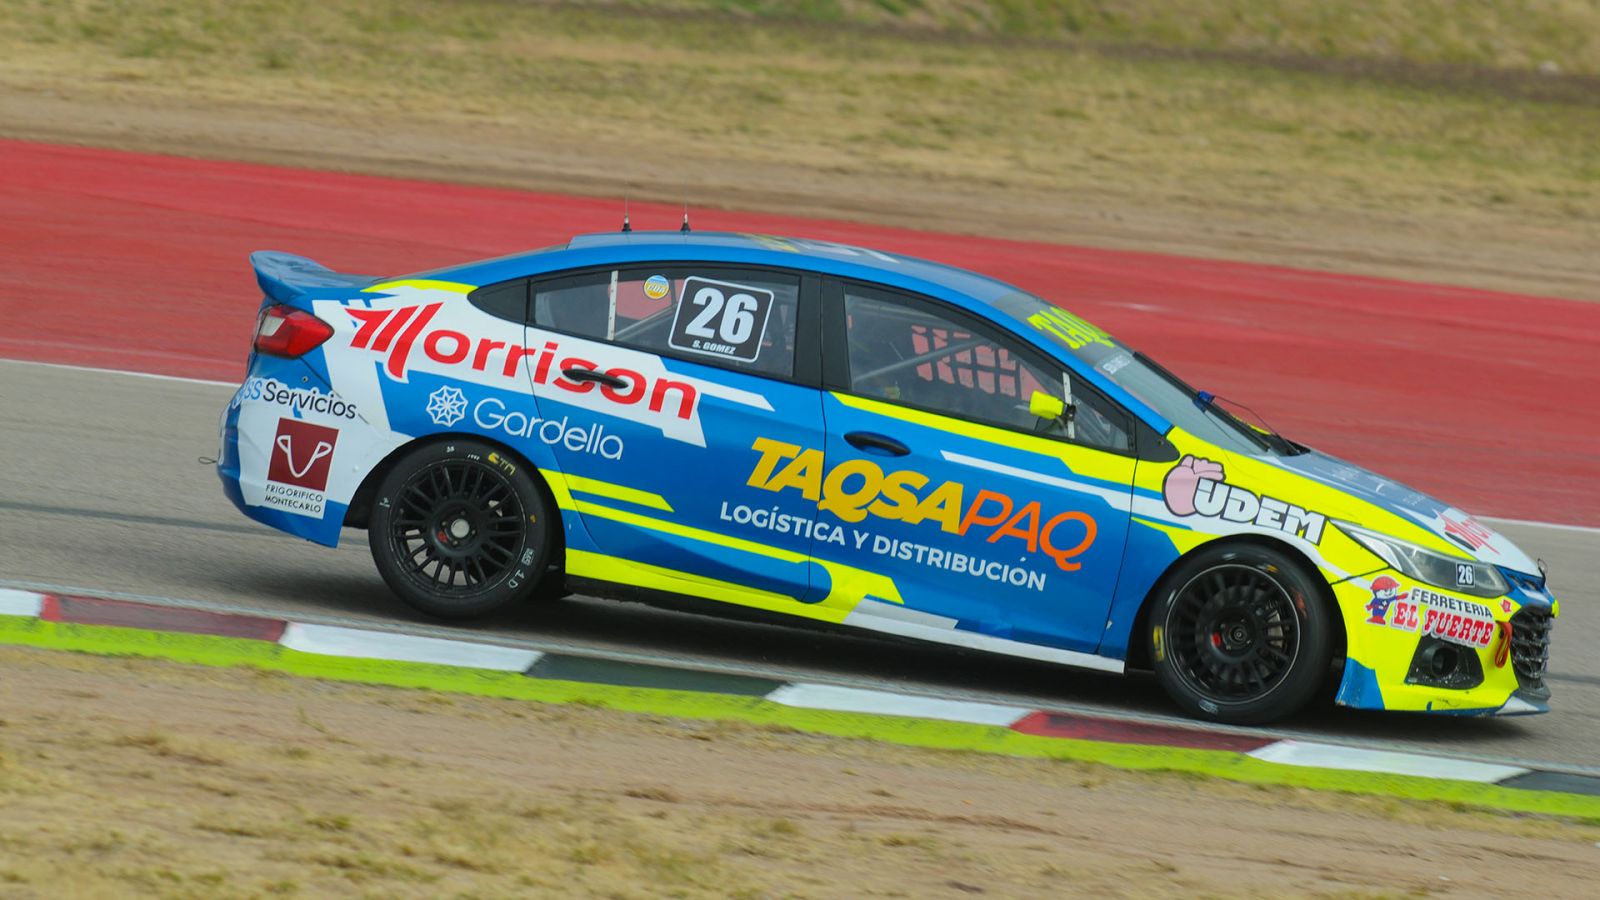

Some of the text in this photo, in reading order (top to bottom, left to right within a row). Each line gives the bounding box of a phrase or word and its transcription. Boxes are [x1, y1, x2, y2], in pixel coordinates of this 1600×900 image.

[685, 287, 758, 344] 26
[344, 302, 697, 420] Morrison
[692, 340, 736, 355] S. GOMEZ
[263, 381, 357, 419] Servicios
[474, 398, 623, 460] Gardella
[264, 495, 322, 513] MONTECARLO
[265, 484, 323, 502] FRIGORIFICO
[1193, 476, 1329, 546] UDEM
[720, 501, 1047, 592] LOGÍSTICA Y DISTRIBUCIÓN
[1458, 565, 1473, 584] 26
[1411, 588, 1493, 618] FERRETERIA
[1393, 602, 1494, 646] EL FUERTE
